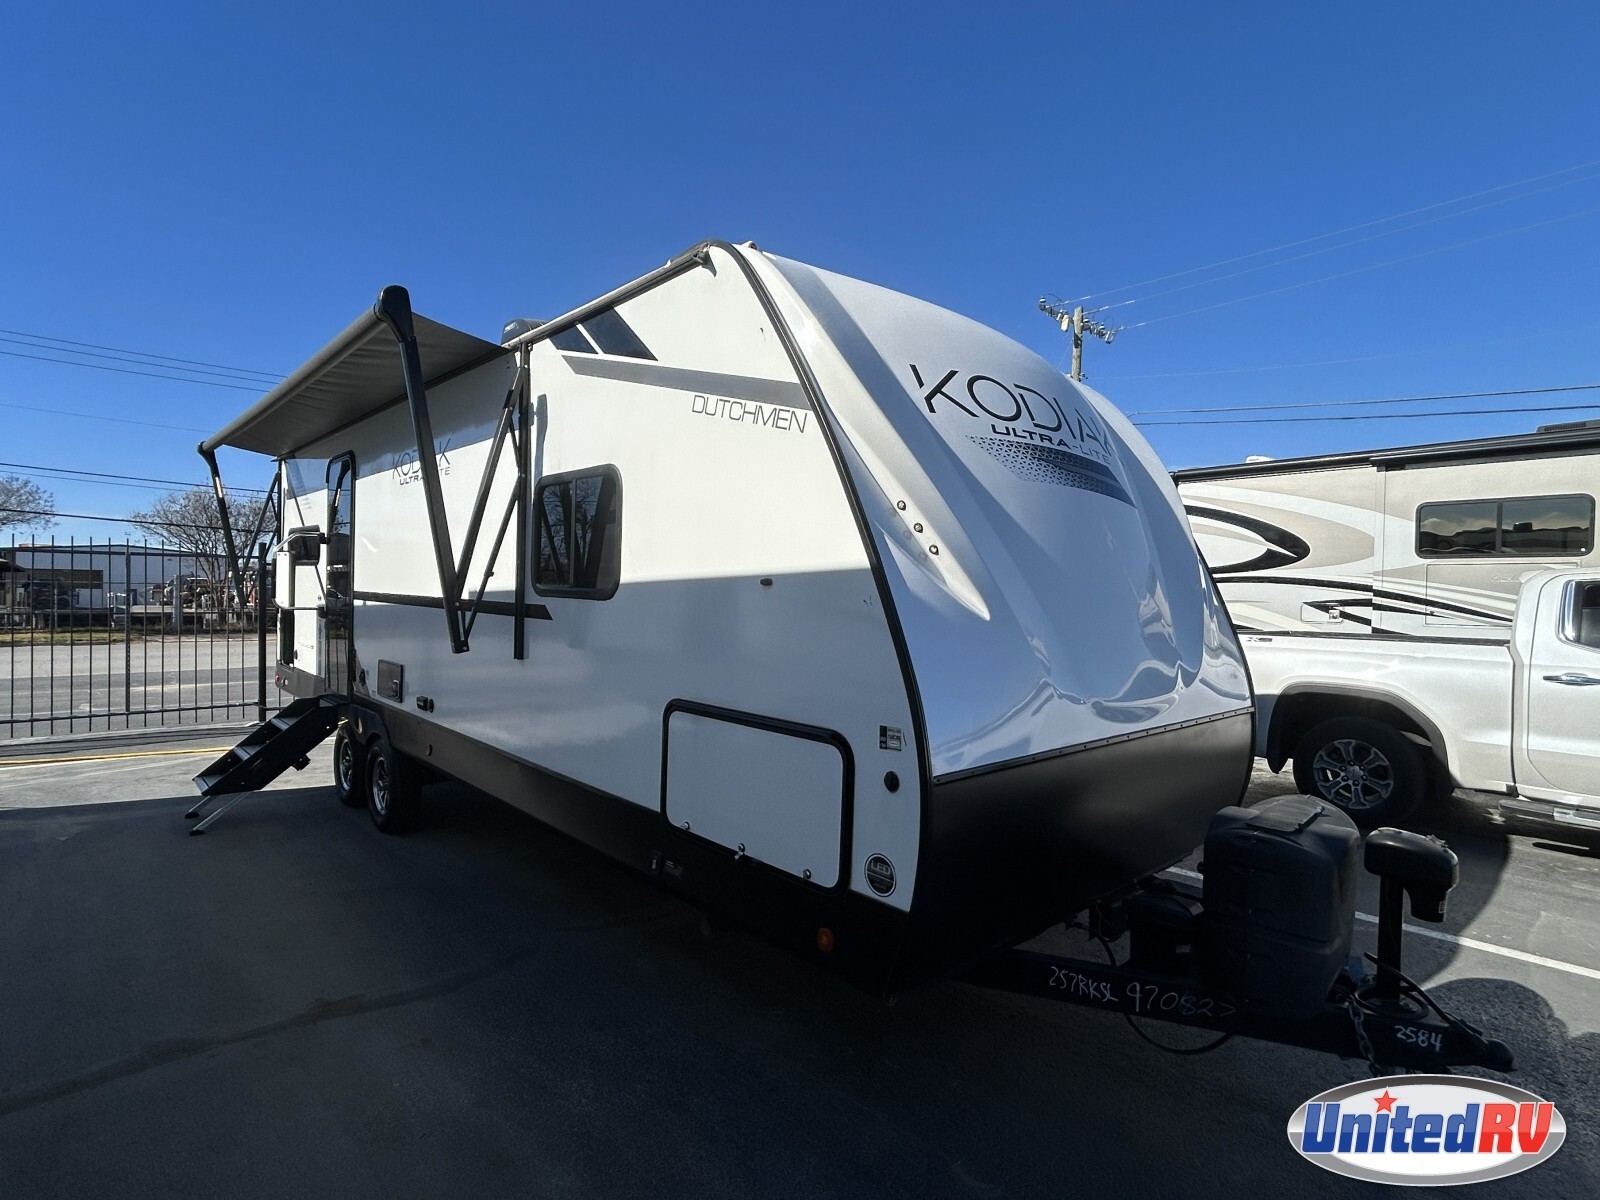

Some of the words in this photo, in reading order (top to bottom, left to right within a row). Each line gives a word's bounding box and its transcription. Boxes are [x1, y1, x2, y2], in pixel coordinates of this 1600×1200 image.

[691, 394, 808, 434] DUTCHMEN
[909, 363, 1124, 466] KODIAK
[392, 437, 451, 479] KODK
[870, 859, 891, 876] LED
[1394, 1025, 1443, 1053] 2584
